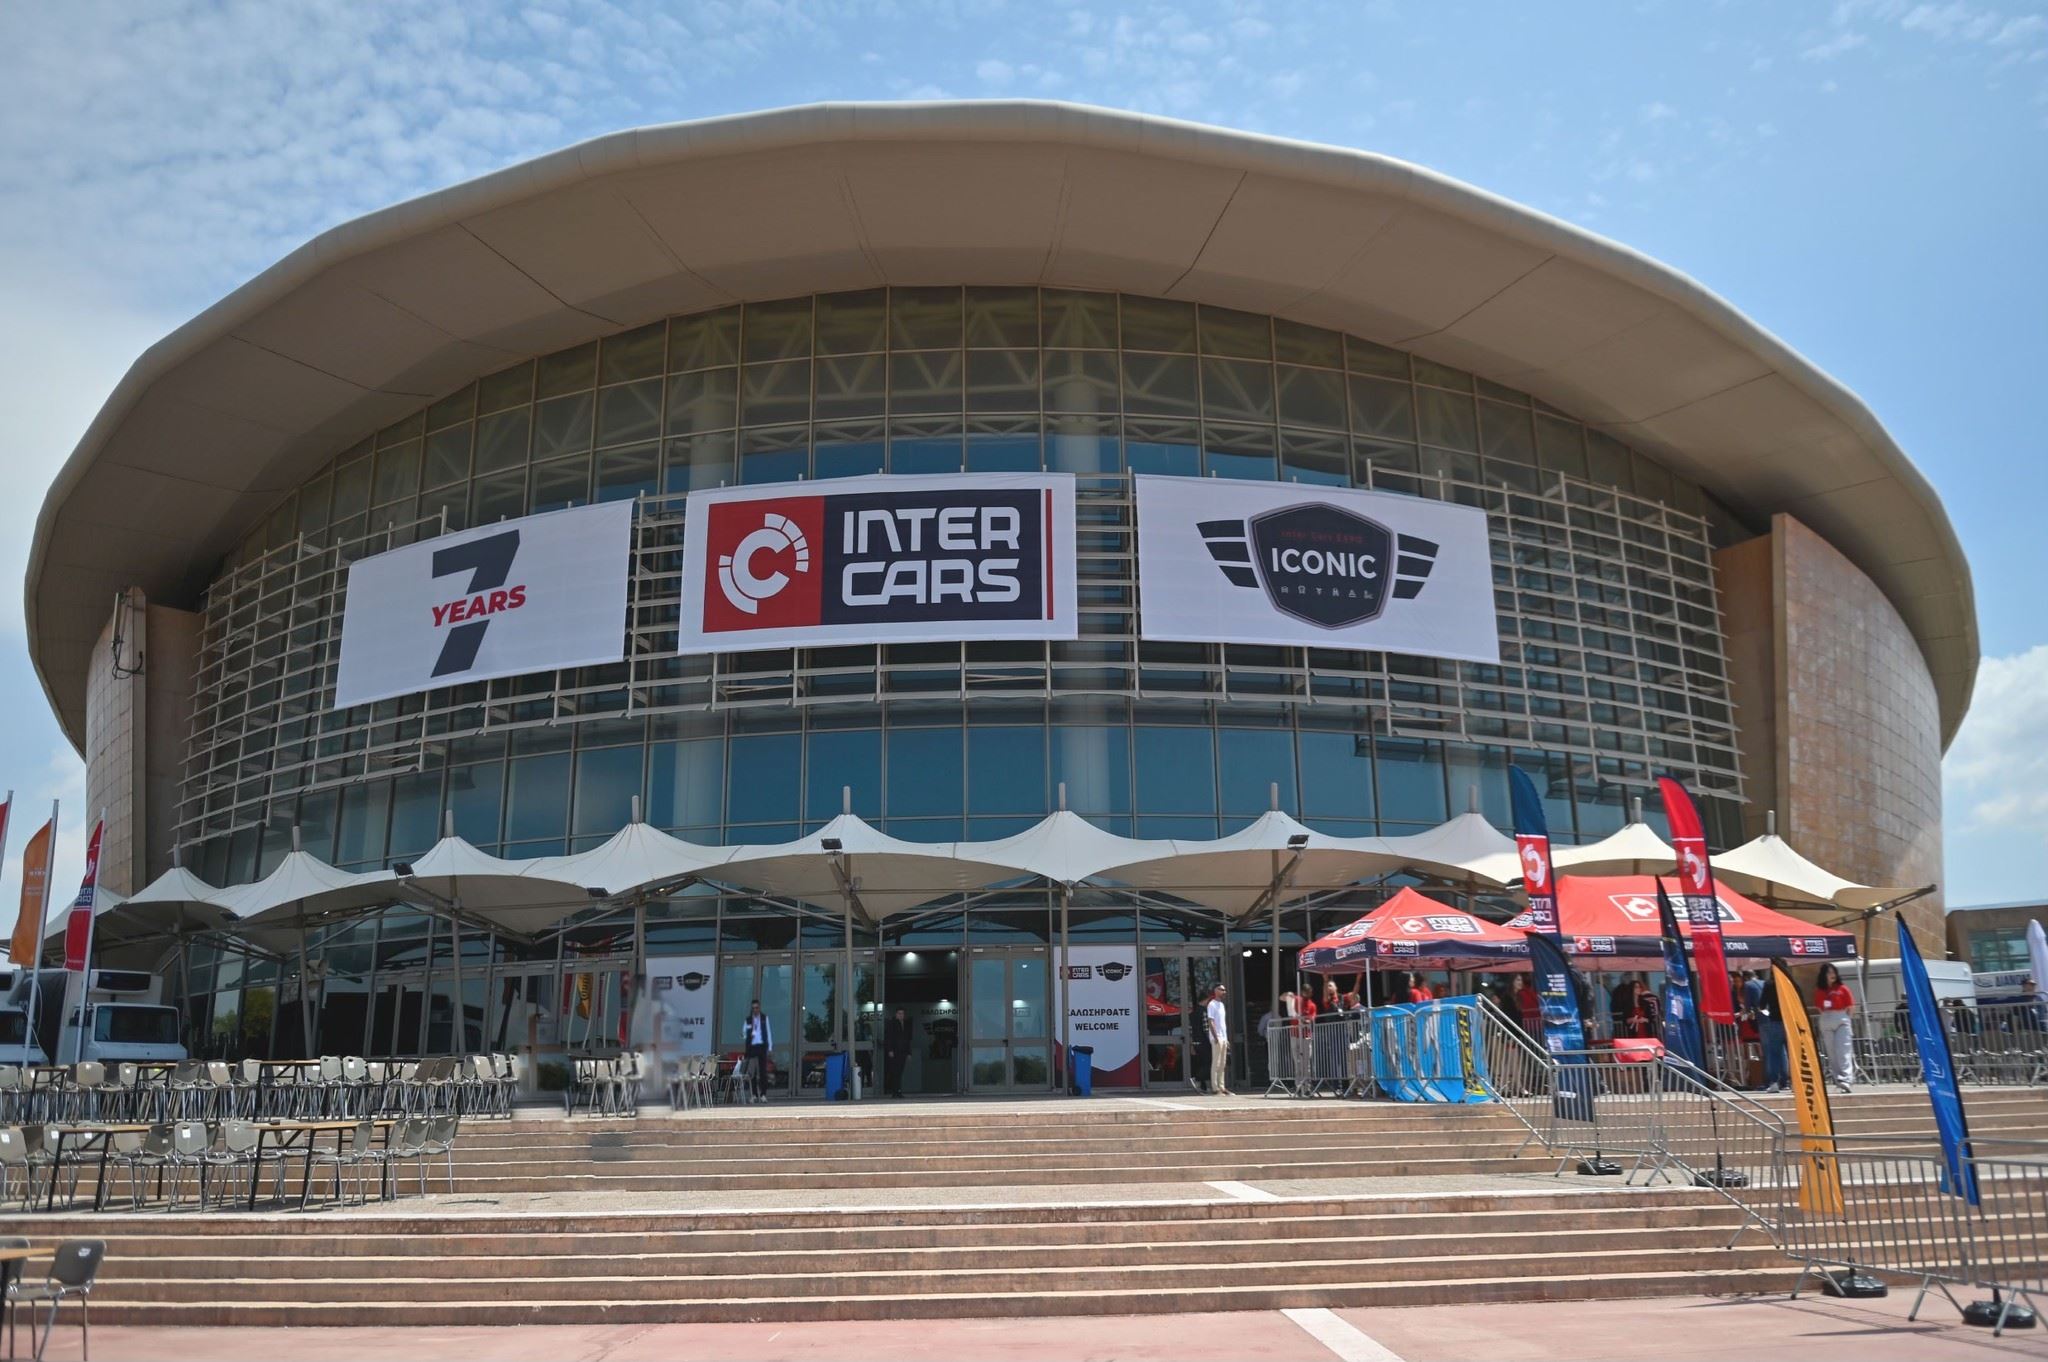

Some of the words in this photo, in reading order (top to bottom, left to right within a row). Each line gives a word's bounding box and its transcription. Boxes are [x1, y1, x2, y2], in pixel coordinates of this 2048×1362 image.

[843, 506, 1020, 554] INTER
[842, 558, 1020, 606] CARS
[1271, 547, 1377, 579] ICONIC
[430, 529, 520, 679] 7
[432, 585, 526, 627] YEARS
[1075, 1022, 1119, 1031] WELCOME
